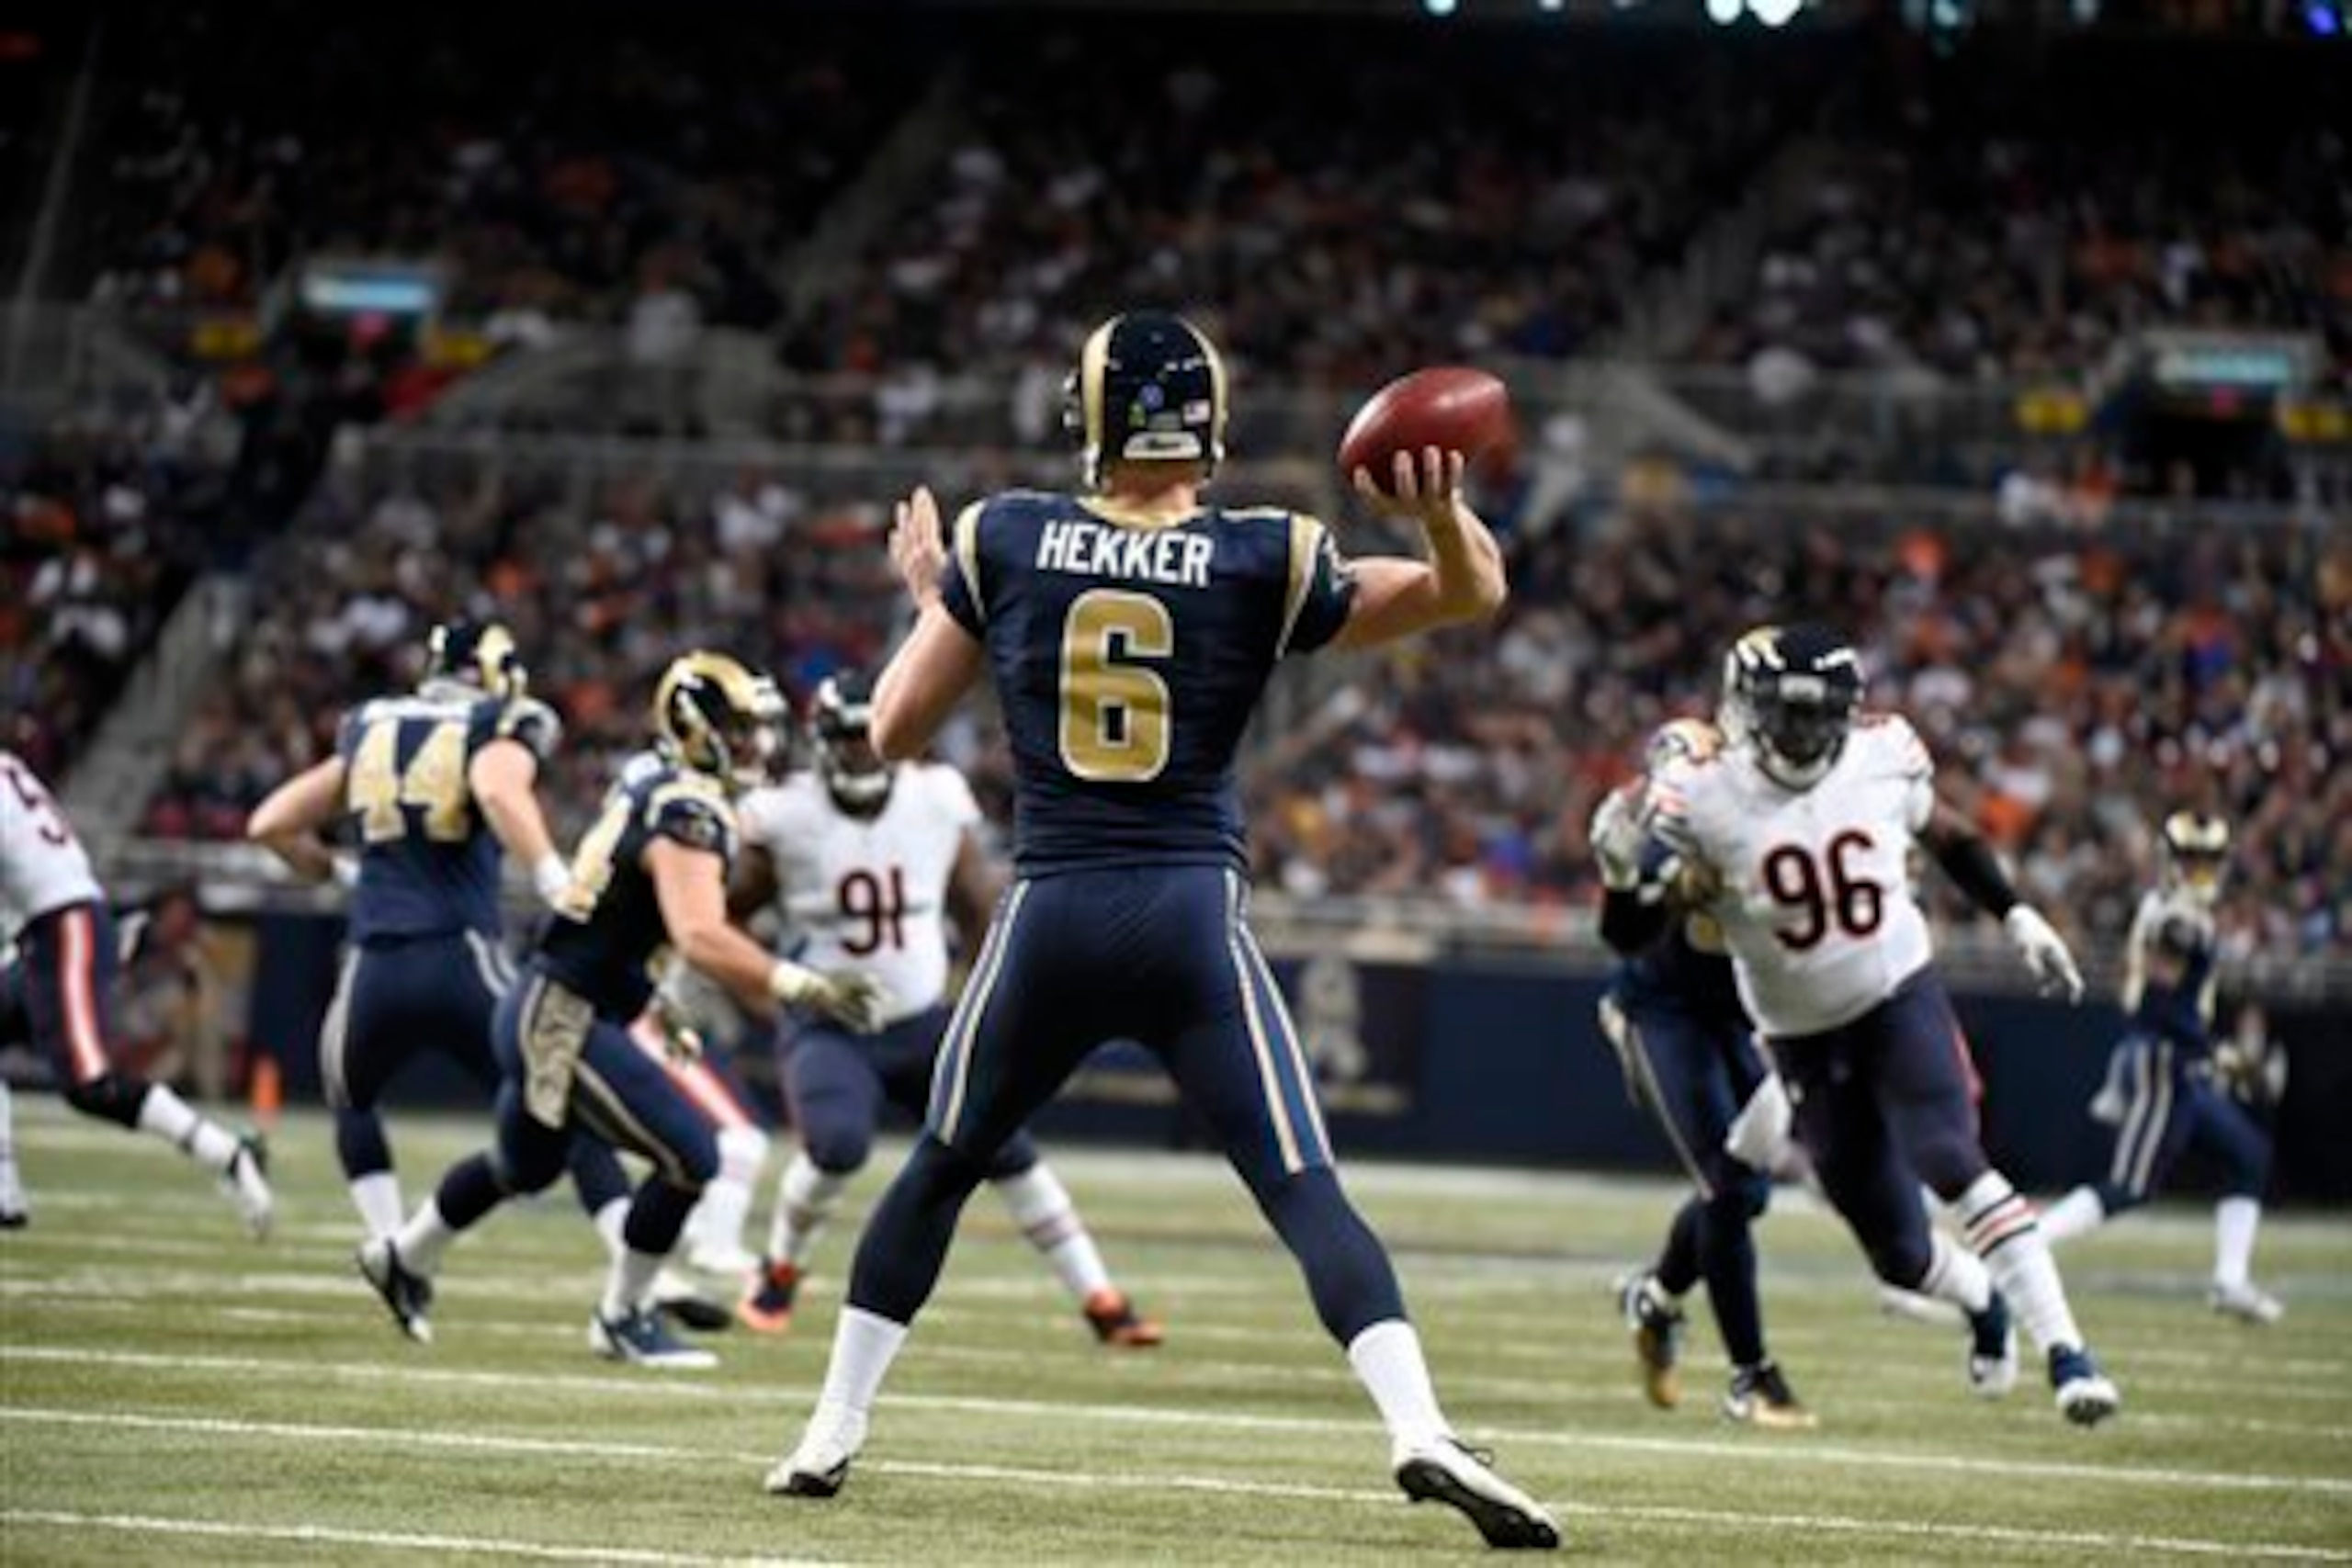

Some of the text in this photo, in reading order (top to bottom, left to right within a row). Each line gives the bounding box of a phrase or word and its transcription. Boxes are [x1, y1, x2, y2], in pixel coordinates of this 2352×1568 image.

[1035, 519, 1214, 587] HEKKER
[1059, 589, 1173, 781] 6
[348, 718, 470, 842] 44
[838, 864, 905, 957] 91
[1762, 829, 1883, 952] 96
